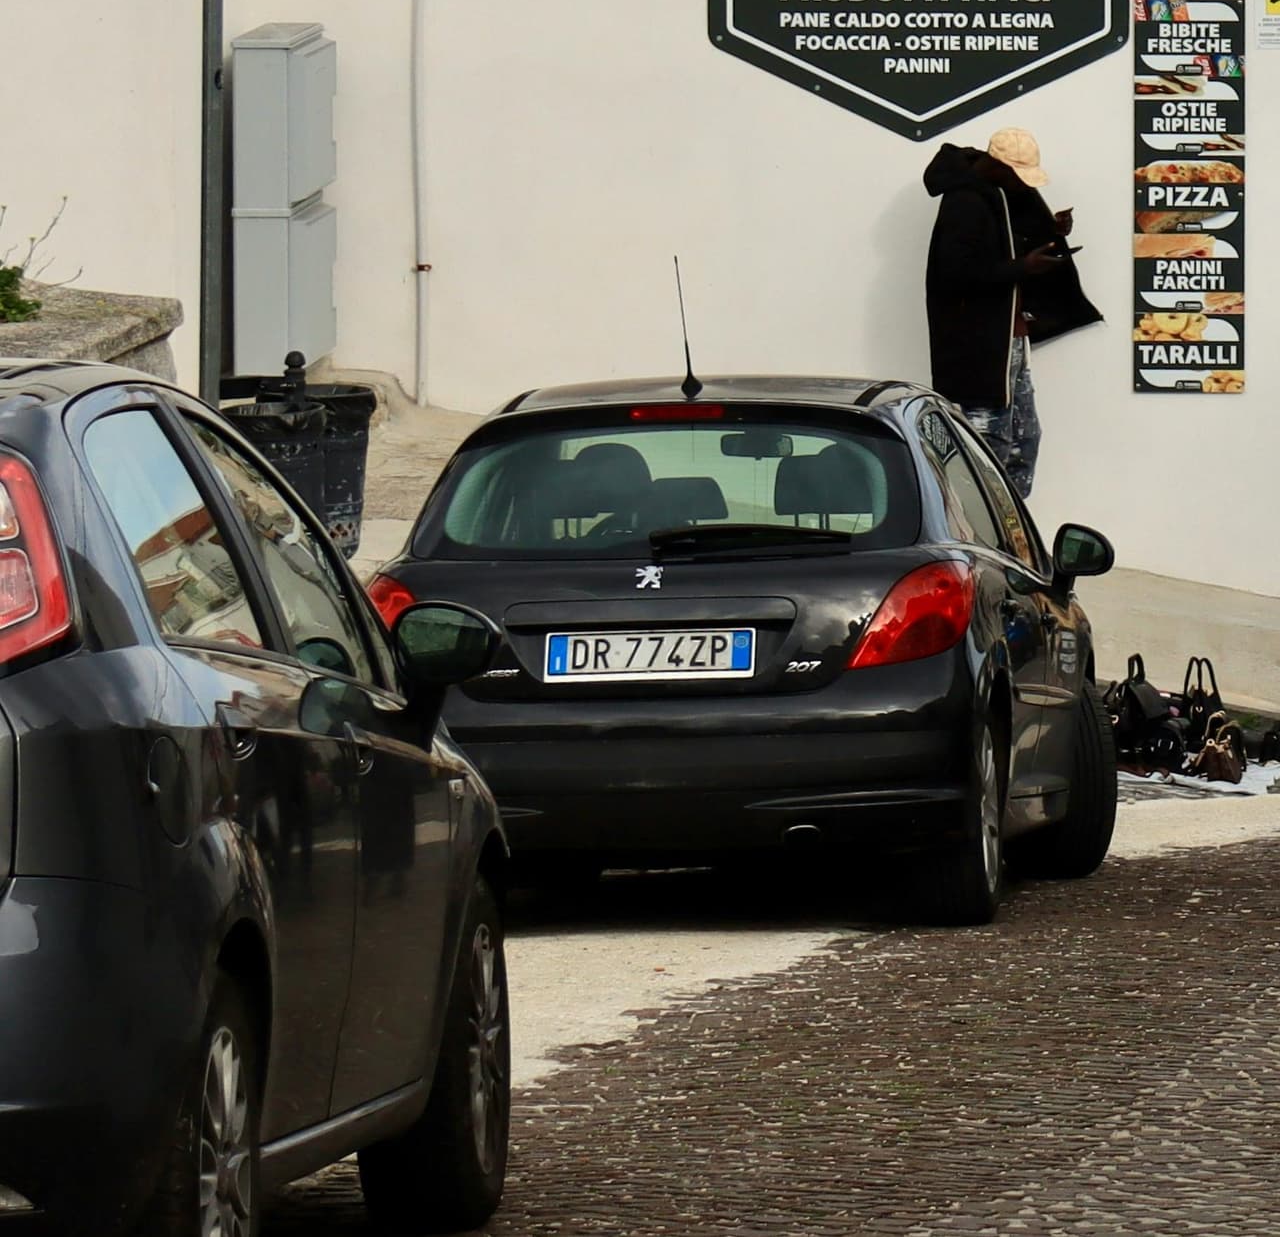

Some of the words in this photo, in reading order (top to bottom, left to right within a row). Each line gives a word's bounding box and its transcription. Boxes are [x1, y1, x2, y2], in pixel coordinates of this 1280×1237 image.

[780, 13, 830, 27] PANE
[834, 13, 900, 27] CALDO
[905, 13, 968, 27] COTTO
[972, 14, 986, 28] A
[991, 13, 1054, 28] LEGNA
[1160, 24, 1219, 37] BIBITE
[796, 35, 890, 50] FOCACCIA
[906, 36, 960, 50] OSTIE
[965, 36, 1038, 50] RIPIENE
[1148, 39, 1231, 52] FRESCHE
[885, 58, 949, 73] PANINI
[1162, 103, 1217, 116] OSTIE
[1153, 118, 1226, 131] RIPIENE
[1149, 187, 1229, 206] PIZZA
[1157, 261, 1221, 274] PANINI
[1154, 276, 1224, 289] FARCITI
[1139, 346, 1236, 364] TARALLI
[571, 638, 609, 670] DR
[625, 635, 729, 669] 774ZP
[785, 661, 821, 673] 207
